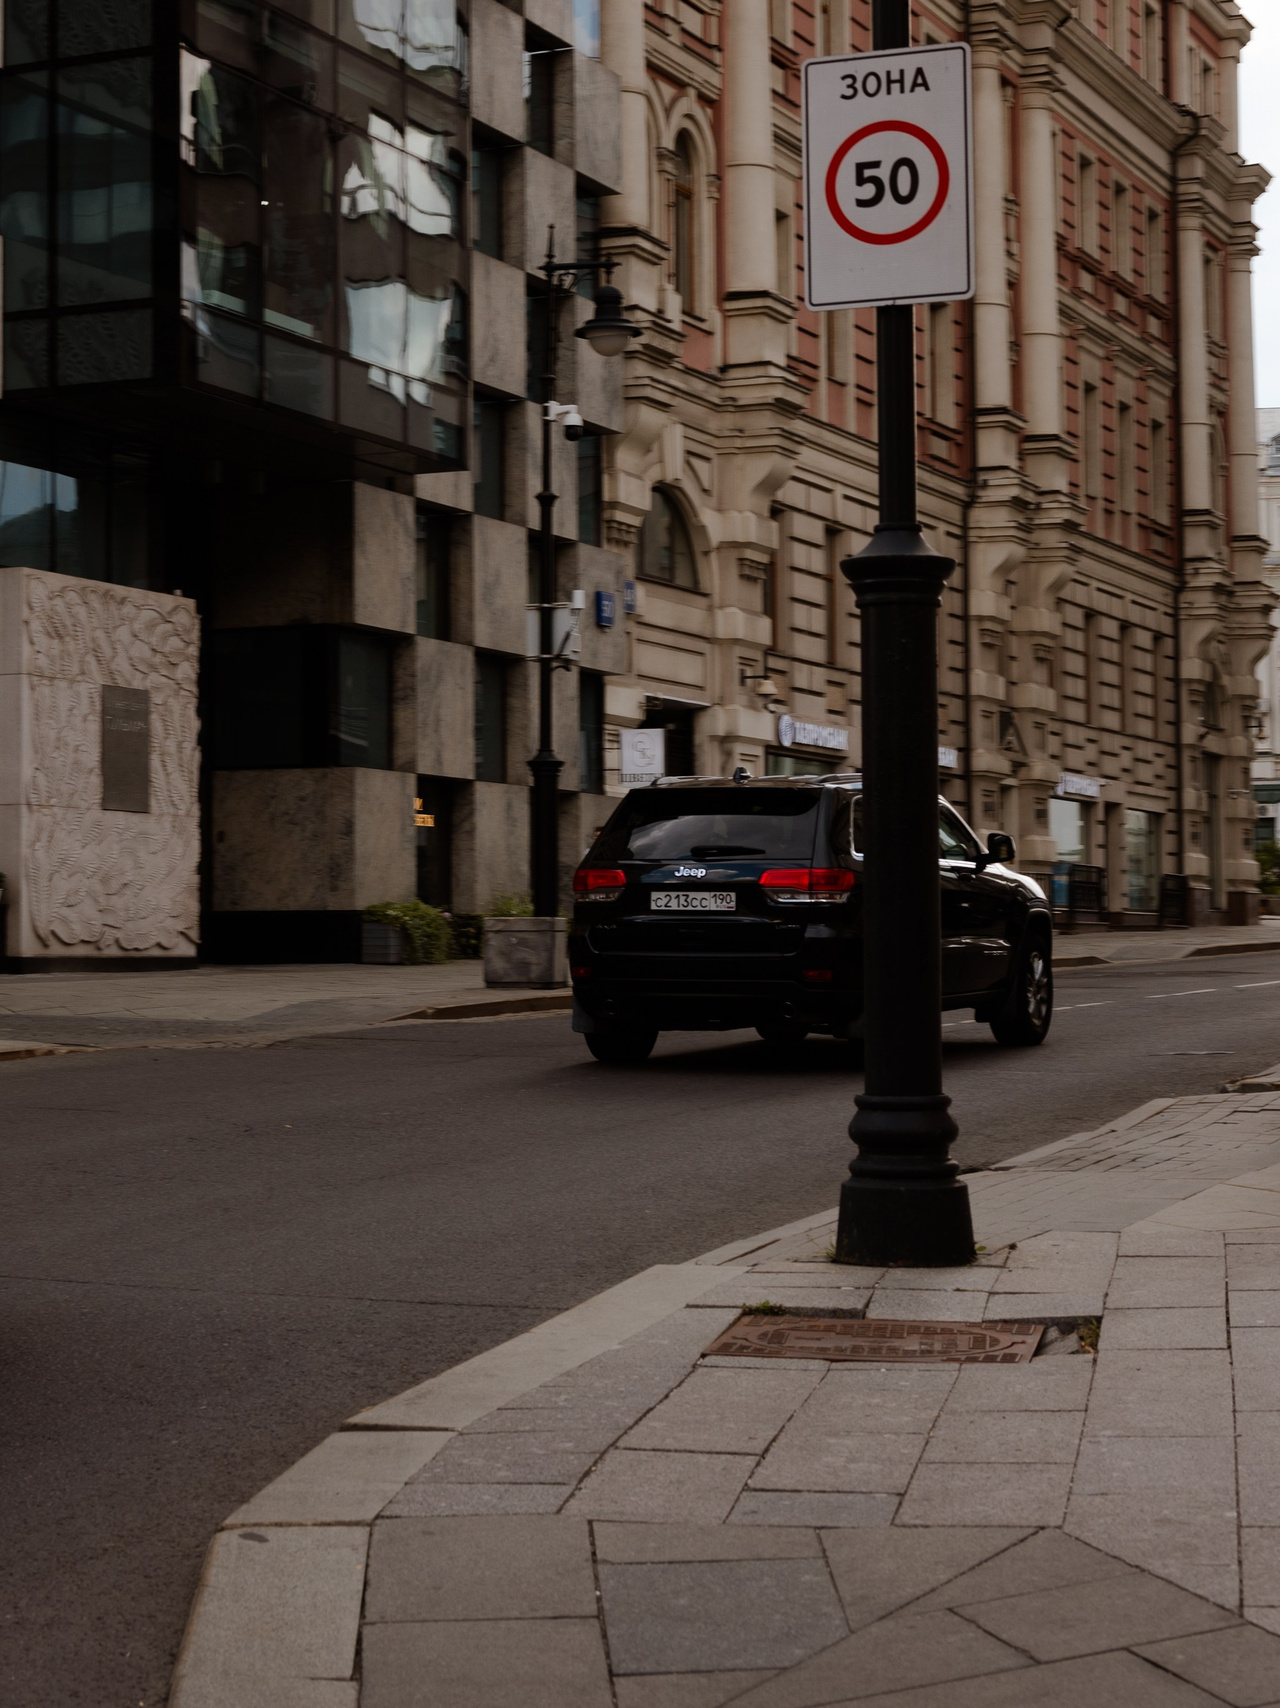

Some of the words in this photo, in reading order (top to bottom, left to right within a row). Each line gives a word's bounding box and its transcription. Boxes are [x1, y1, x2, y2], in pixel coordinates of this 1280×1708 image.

[840, 66, 931, 100] ЗОНА
[854, 156, 920, 208] 50
[674, 866, 707, 879] Jeep
[711, 893, 732, 905] 190
